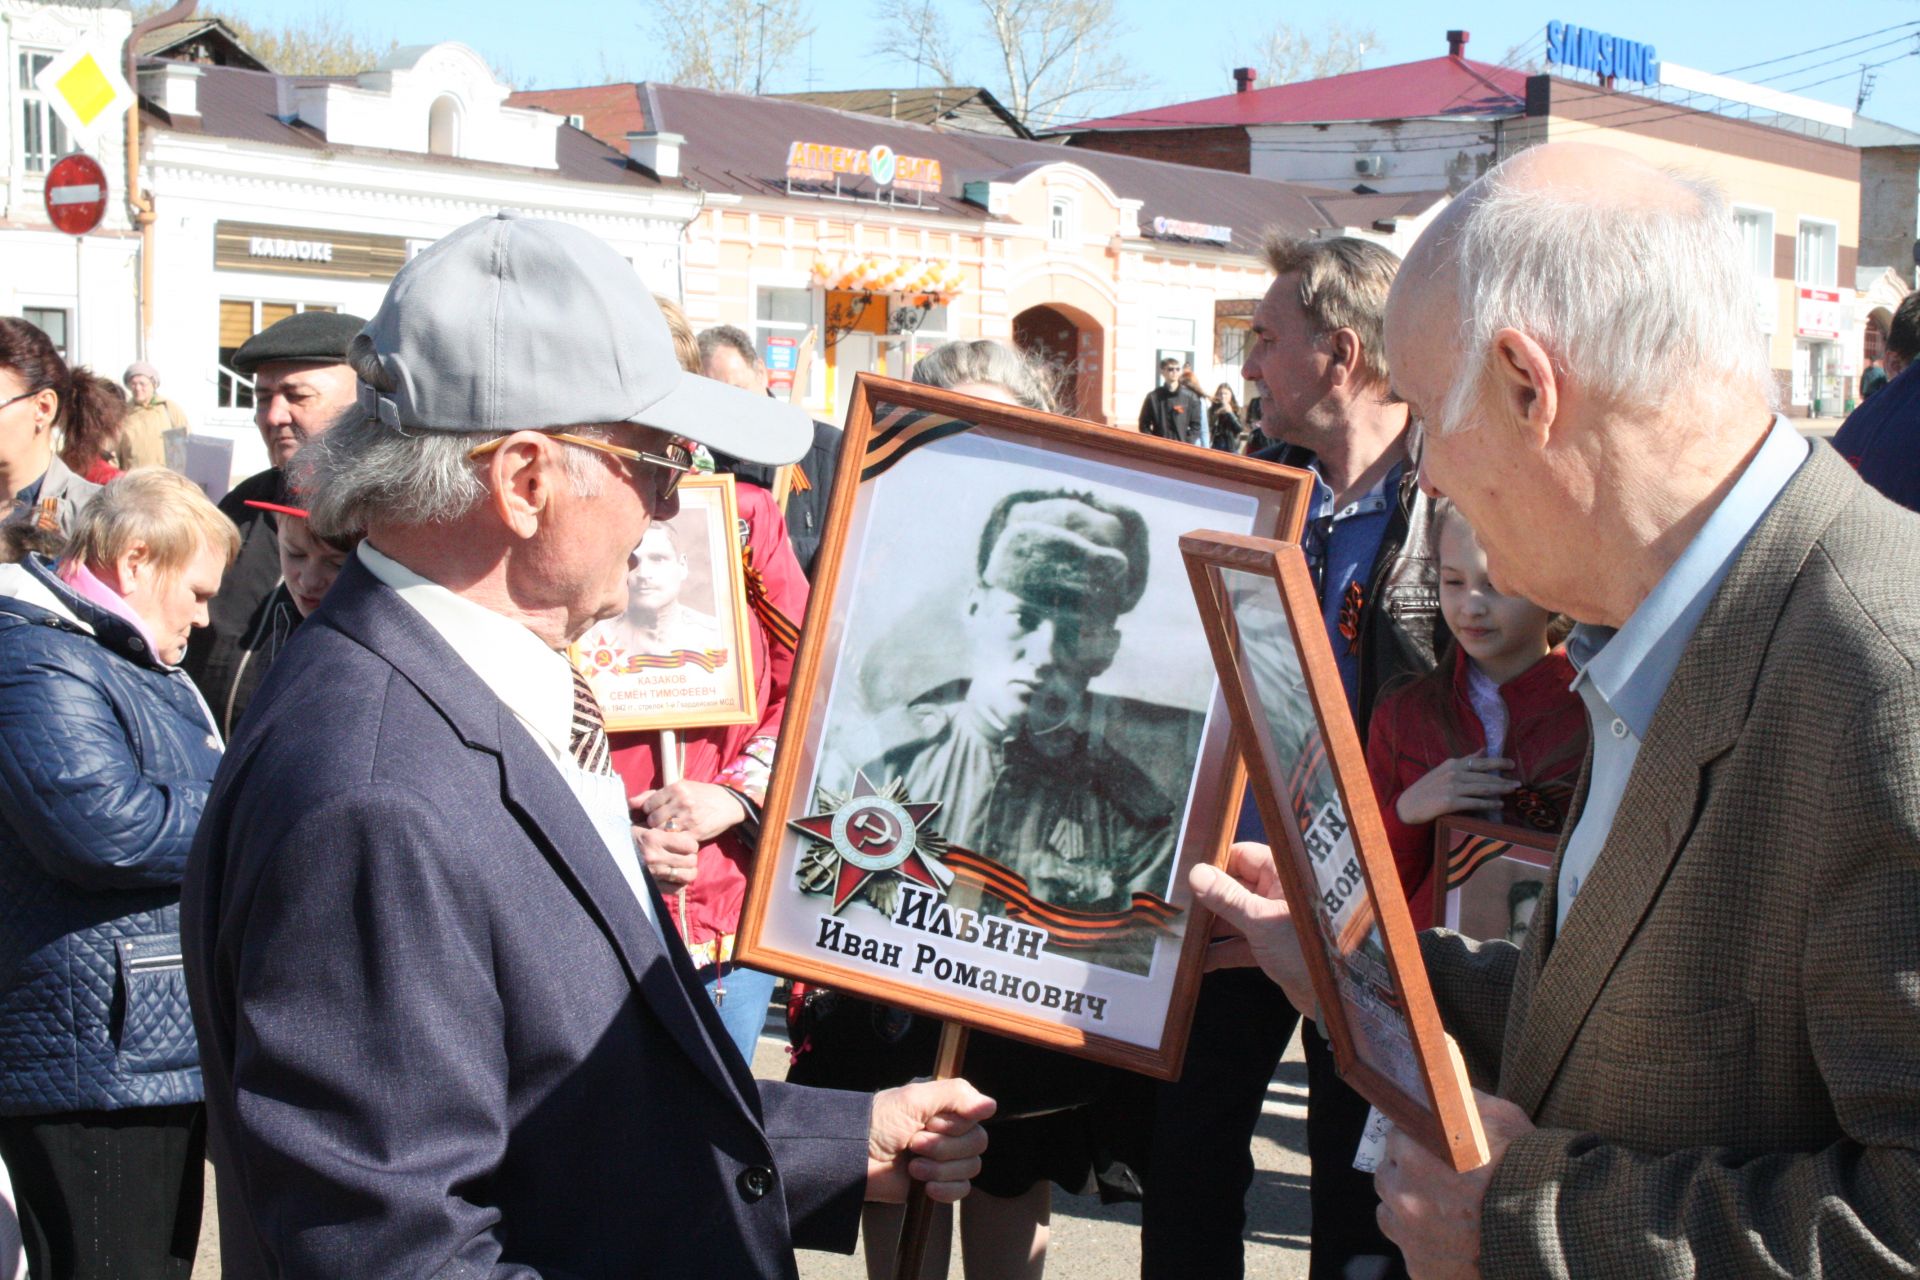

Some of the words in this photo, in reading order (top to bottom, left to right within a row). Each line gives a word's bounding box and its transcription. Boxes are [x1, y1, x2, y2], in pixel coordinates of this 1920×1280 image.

[1547, 20, 1656, 86] SAMSUNG
[786, 141, 870, 175] АПТЕКА
[894, 154, 943, 185] ВИТА
[249, 237, 333, 262] KARAOKE
[609, 690, 647, 701] СЕМЕН
[638, 674, 687, 686] КАЗАКОВ
[612, 703, 626, 712] 1942
[896, 887, 1043, 960] Ильин
[816, 918, 903, 968] Иван
[912, 943, 1107, 1020] Романович
